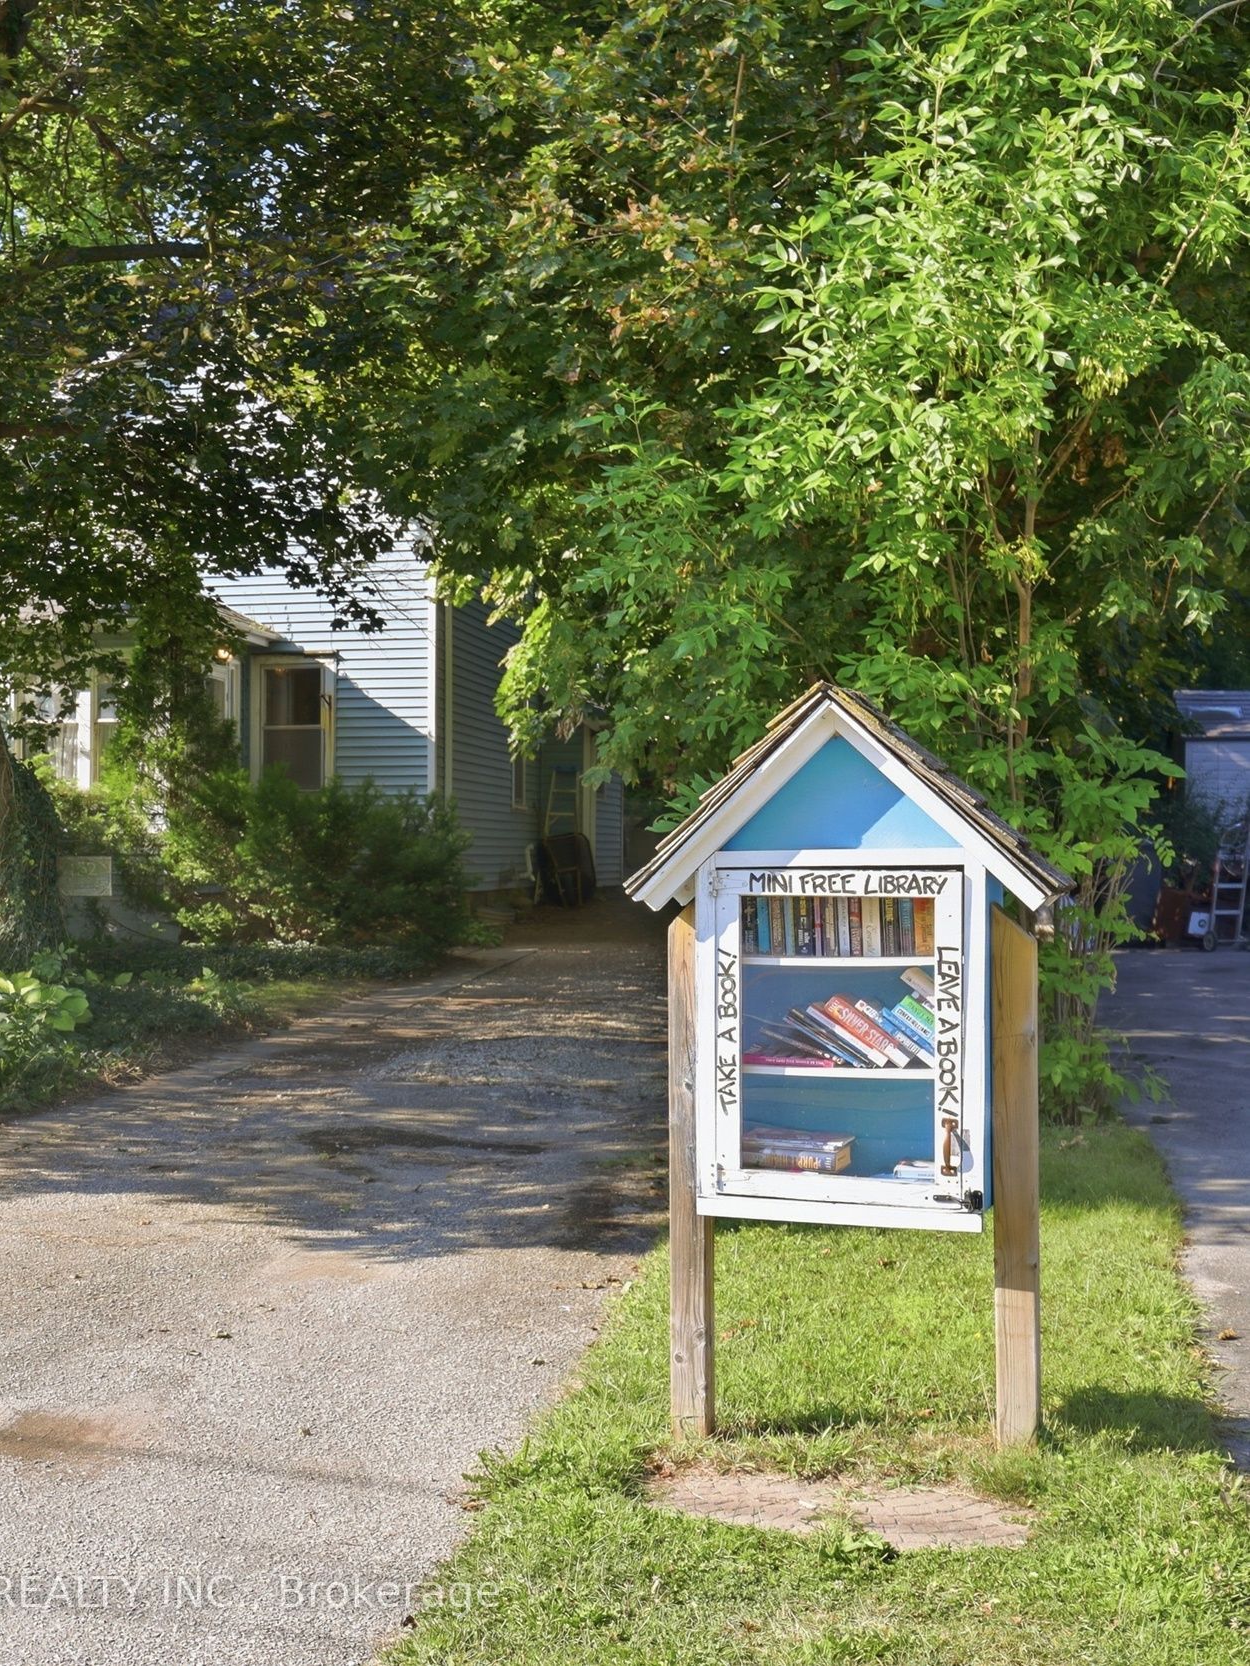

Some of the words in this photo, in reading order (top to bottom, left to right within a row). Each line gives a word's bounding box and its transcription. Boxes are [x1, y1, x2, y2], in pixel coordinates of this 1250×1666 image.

[749, 873, 793, 893] MINI
[800, 873, 857, 894] FREE
[864, 874, 948, 895] LIBRARY
[717, 948, 738, 1020] BOOK!
[936, 946, 960, 1012] LEAVE
[717, 1027, 737, 1043] A
[839, 1007, 869, 1037] SILVER
[938, 1017, 960, 1035] A
[716, 1054, 737, 1116] TAKE
[937, 1037, 959, 1117] BOOK!
